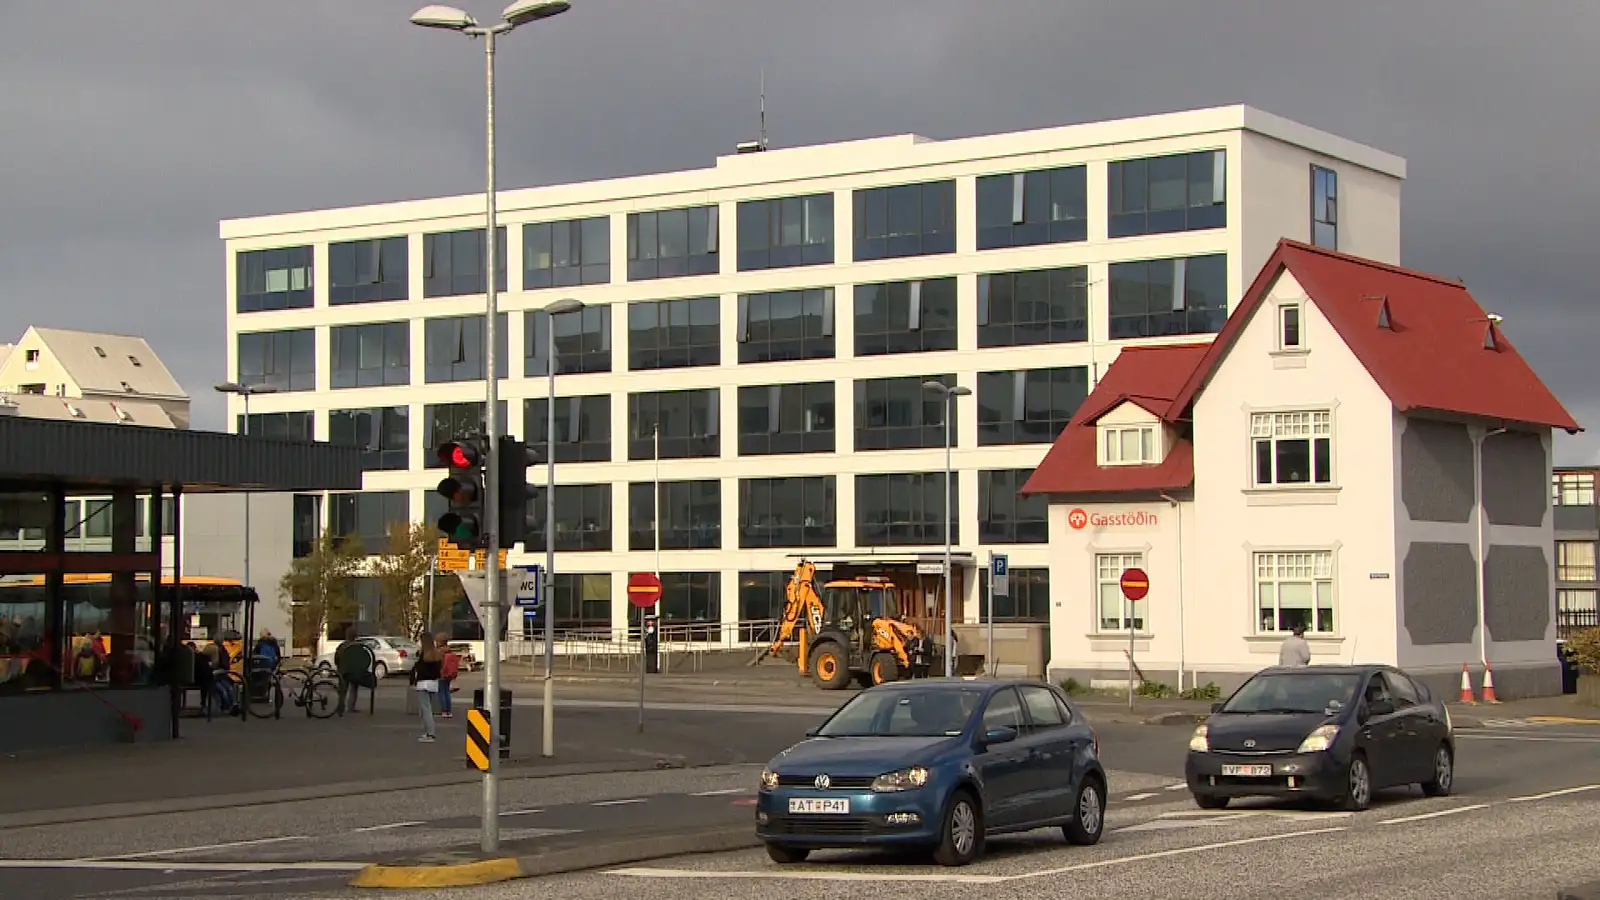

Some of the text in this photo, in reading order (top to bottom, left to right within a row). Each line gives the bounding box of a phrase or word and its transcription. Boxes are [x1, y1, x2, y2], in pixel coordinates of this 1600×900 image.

[1090, 511, 1158, 526] Gasstöðin
[996, 559, 1004, 573] P
[797, 800, 845, 812] AT P41
